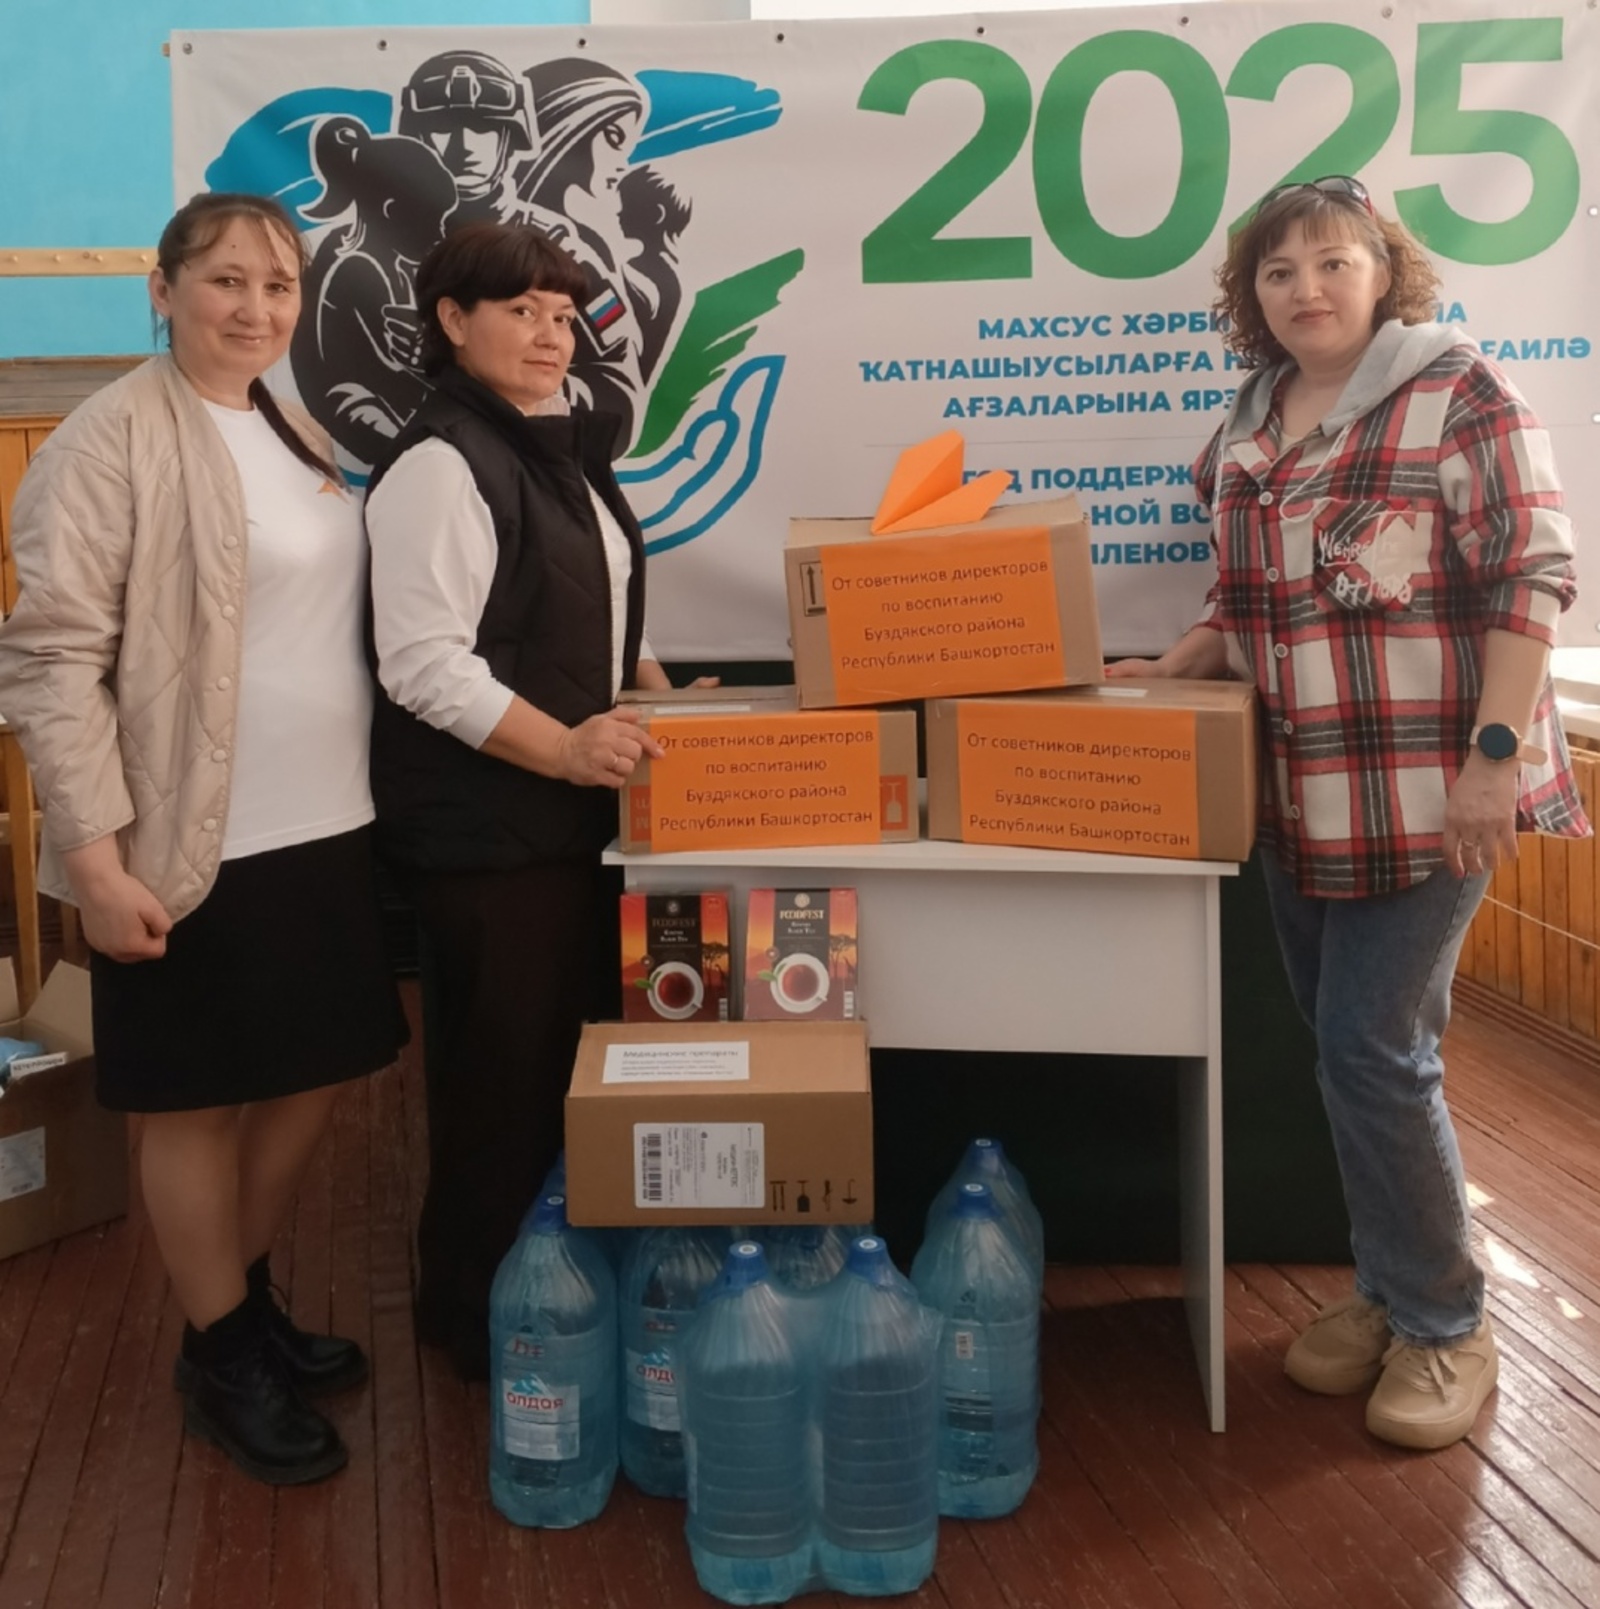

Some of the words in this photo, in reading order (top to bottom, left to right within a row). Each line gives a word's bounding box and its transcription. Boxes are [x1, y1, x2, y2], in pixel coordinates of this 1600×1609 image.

[857, 17, 1581, 284] 2025
[978, 314, 1112, 340] МАХСУС
[858, 350, 1214, 382] ҠАТНАШЫУСЫЛАРҒА
[942, 390, 1172, 418] АҒЗАЛАРЫНА
[1031, 464, 1197, 492] ПОДДЕРЖ
[1091, 498, 1160, 526] НОЙ
[1171, 502, 1212, 525] ВО
[832, 576, 852, 591] От
[856, 569, 948, 590] советников
[951, 559, 1049, 583] директоров
[881, 600, 901, 613] по
[905, 590, 1004, 612] воспитанию
[864, 623, 963, 643] Буздякского
[966, 615, 1026, 634] района
[841, 651, 935, 670] Республики
[939, 642, 1055, 662] Башкортостан
[657, 735, 677, 750] От
[681, 733, 774, 749] советников
[778, 729, 874, 747] директоров
[967, 732, 987, 748] От
[991, 737, 1085, 754] советников
[1089, 744, 1191, 762] директоров
[705, 763, 726, 775] по
[730, 759, 827, 774] воспитанию
[1014, 766, 1034, 778] по
[1039, 768, 1141, 786] воспитанию
[686, 787, 785, 804] Буздякского
[789, 784, 847, 800] района
[995, 789, 1096, 810] Буздякского
[1100, 799, 1162, 816] района
[659, 814, 756, 831] Республики
[760, 810, 873, 827] Башкортостан
[969, 814, 1065, 836] Республики
[1069, 823, 1190, 846] Башкортостан
